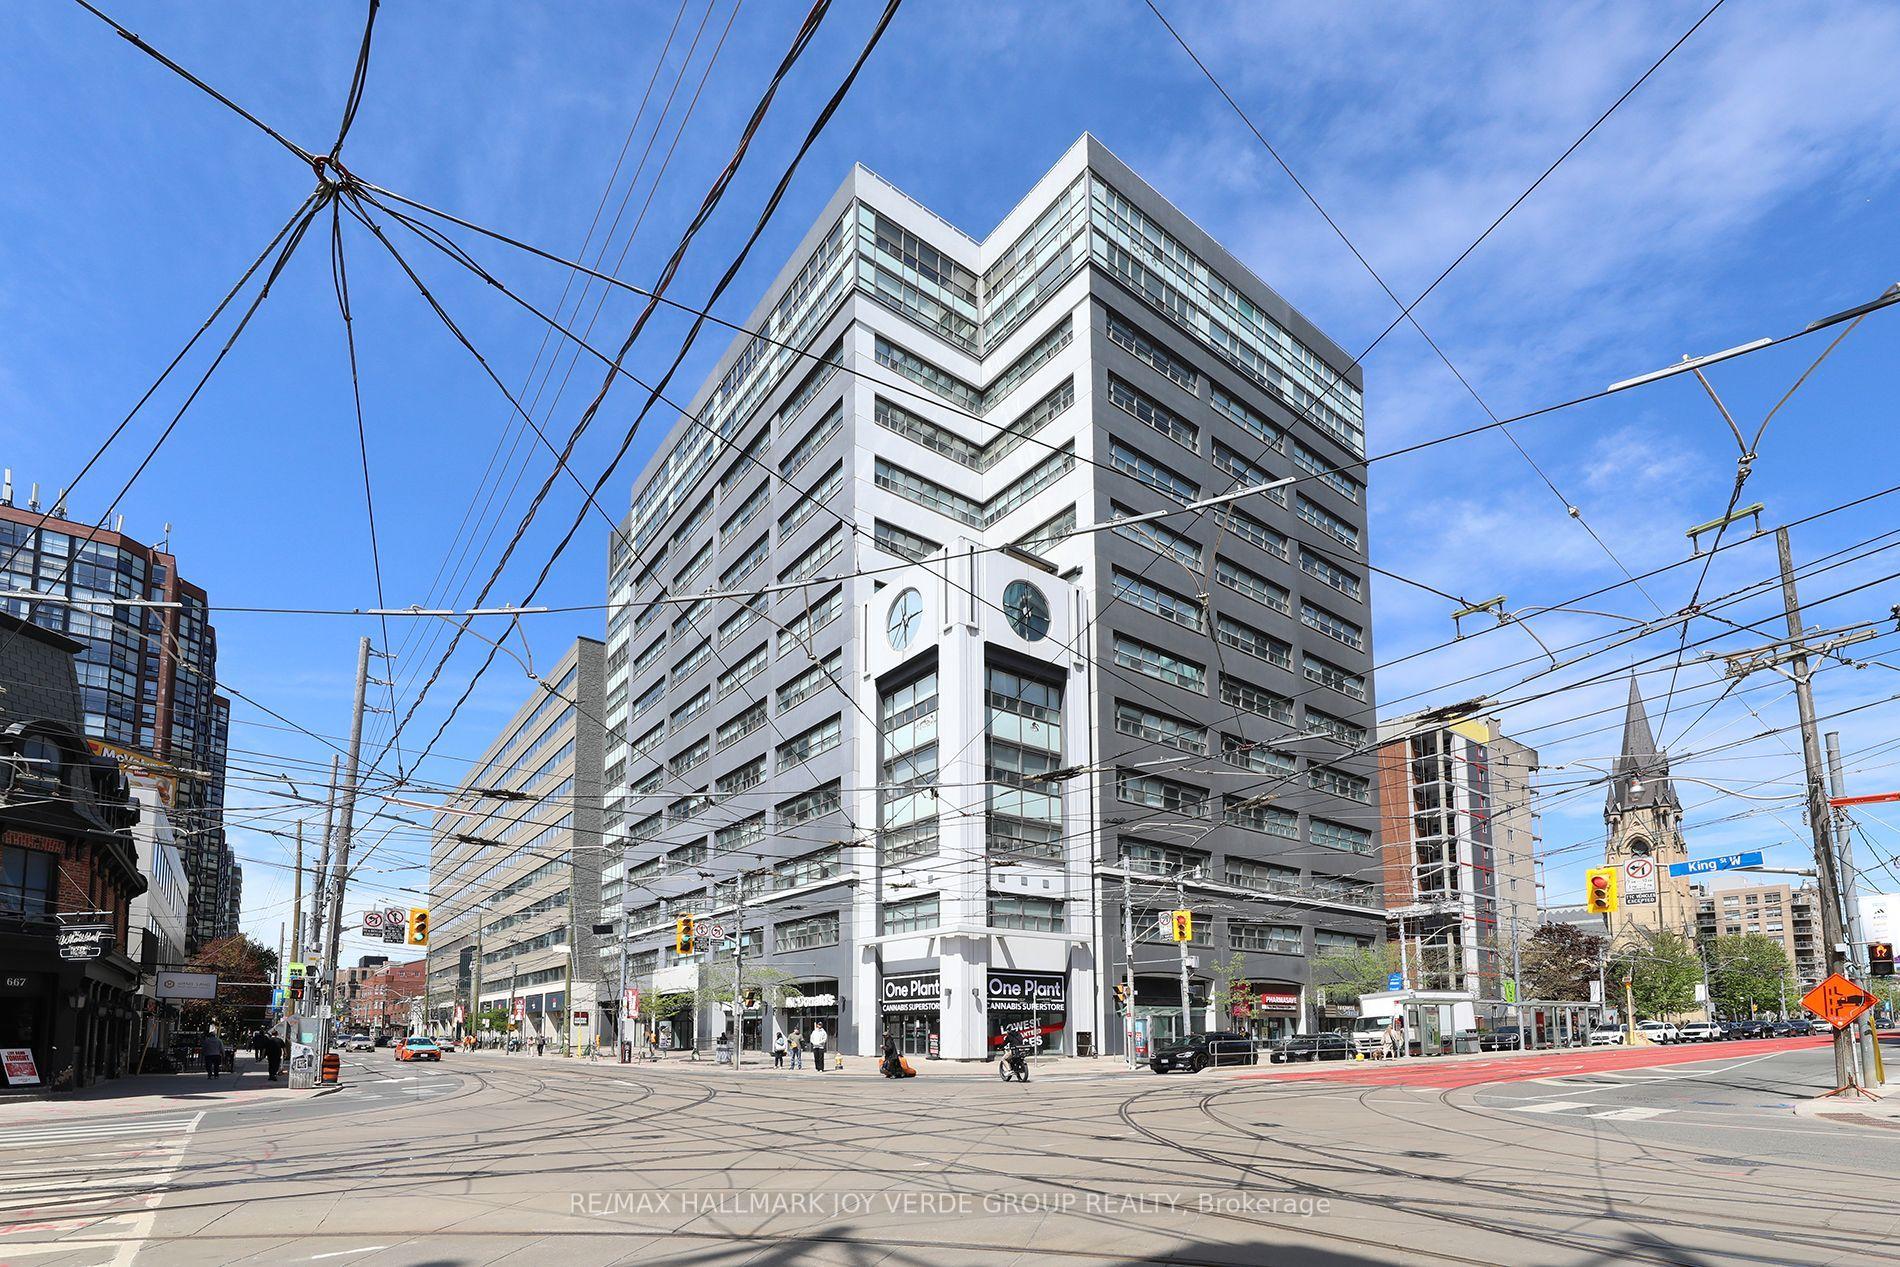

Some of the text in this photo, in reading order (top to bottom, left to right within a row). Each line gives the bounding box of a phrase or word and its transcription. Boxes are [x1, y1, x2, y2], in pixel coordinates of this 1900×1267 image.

[1688, 861, 1717, 872] King
[1729, 856, 1741, 866] W
[7, 978, 26, 986] 667
[886, 980, 940, 997] One Plant
[989, 978, 1060, 996] One Plant
[1023, 1003, 1064, 1011] SUPERSTORE
[1266, 996, 1297, 1004] PHARMASAVE
[1000, 1018, 1041, 1035] LOWEST
